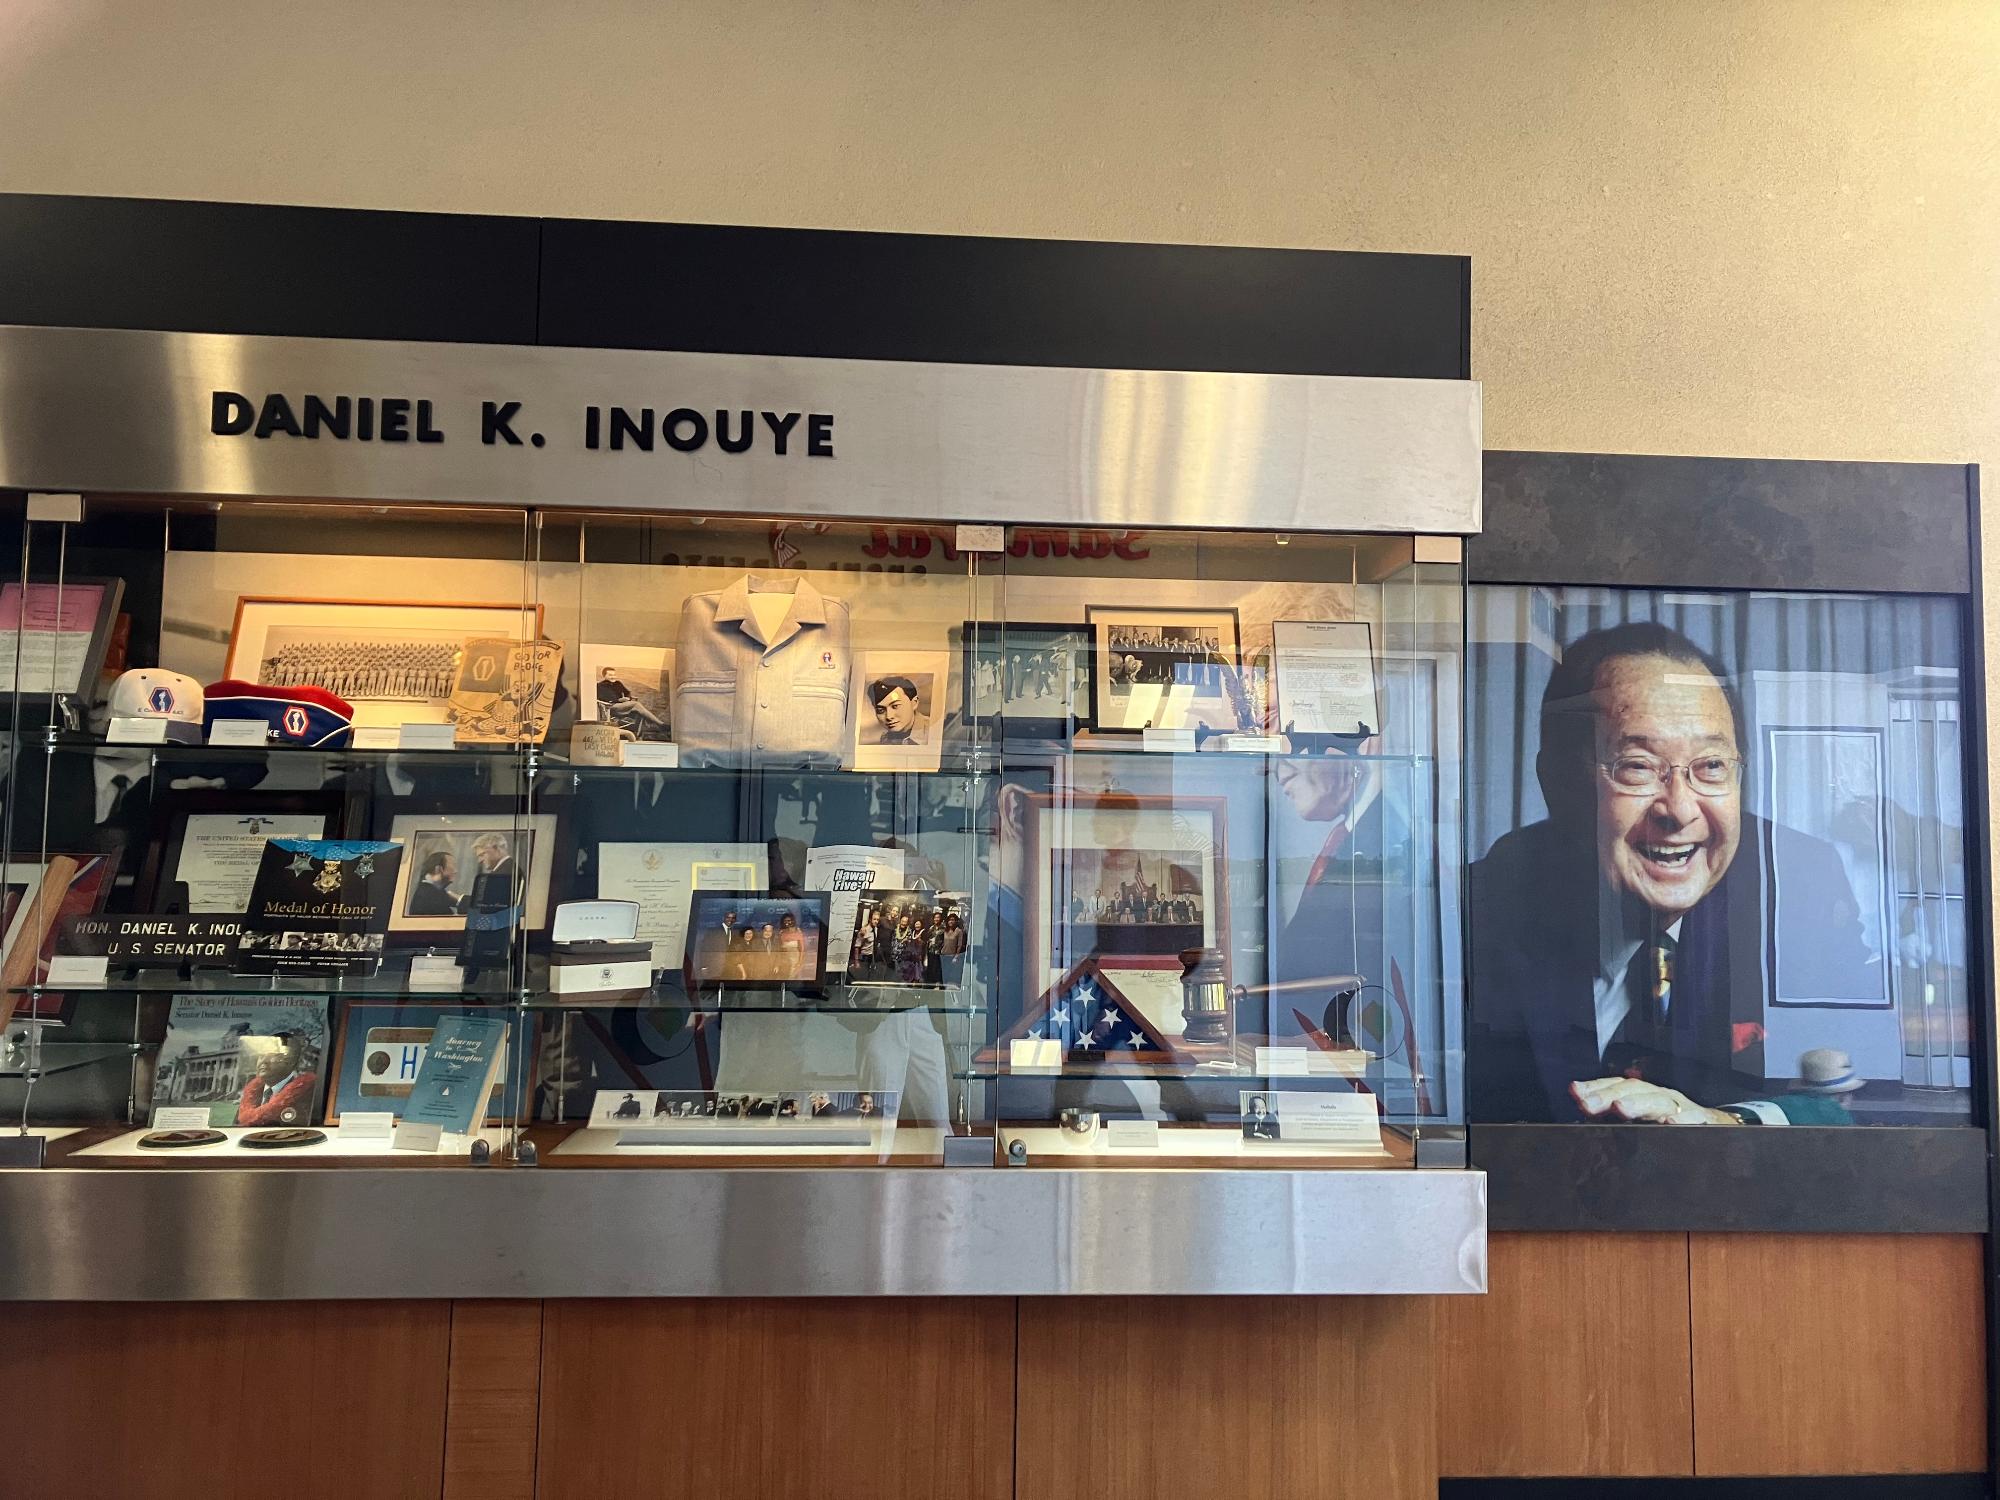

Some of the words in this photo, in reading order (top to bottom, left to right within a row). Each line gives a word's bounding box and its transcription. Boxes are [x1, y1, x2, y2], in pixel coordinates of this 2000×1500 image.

[211, 390, 444, 444] DANIEL
[481, 401, 546, 447] K.
[585, 405, 835, 457] INOUYE
[834, 868, 876, 881] Hawaii
[264, 901, 308, 913] Medal
[311, 902, 329, 914] of
[331, 903, 377, 915] Honor
[75, 922, 112, 934] HON.
[120, 922, 177, 935] DANIEL
[187, 923, 203, 935] K.
[108, 942, 123, 954] U.
[130, 942, 145, 954] S.
[153, 943, 226, 956] SENATOR
[446, 1036, 482, 1049] Journey
[434, 1051, 484, 1063] Washington
